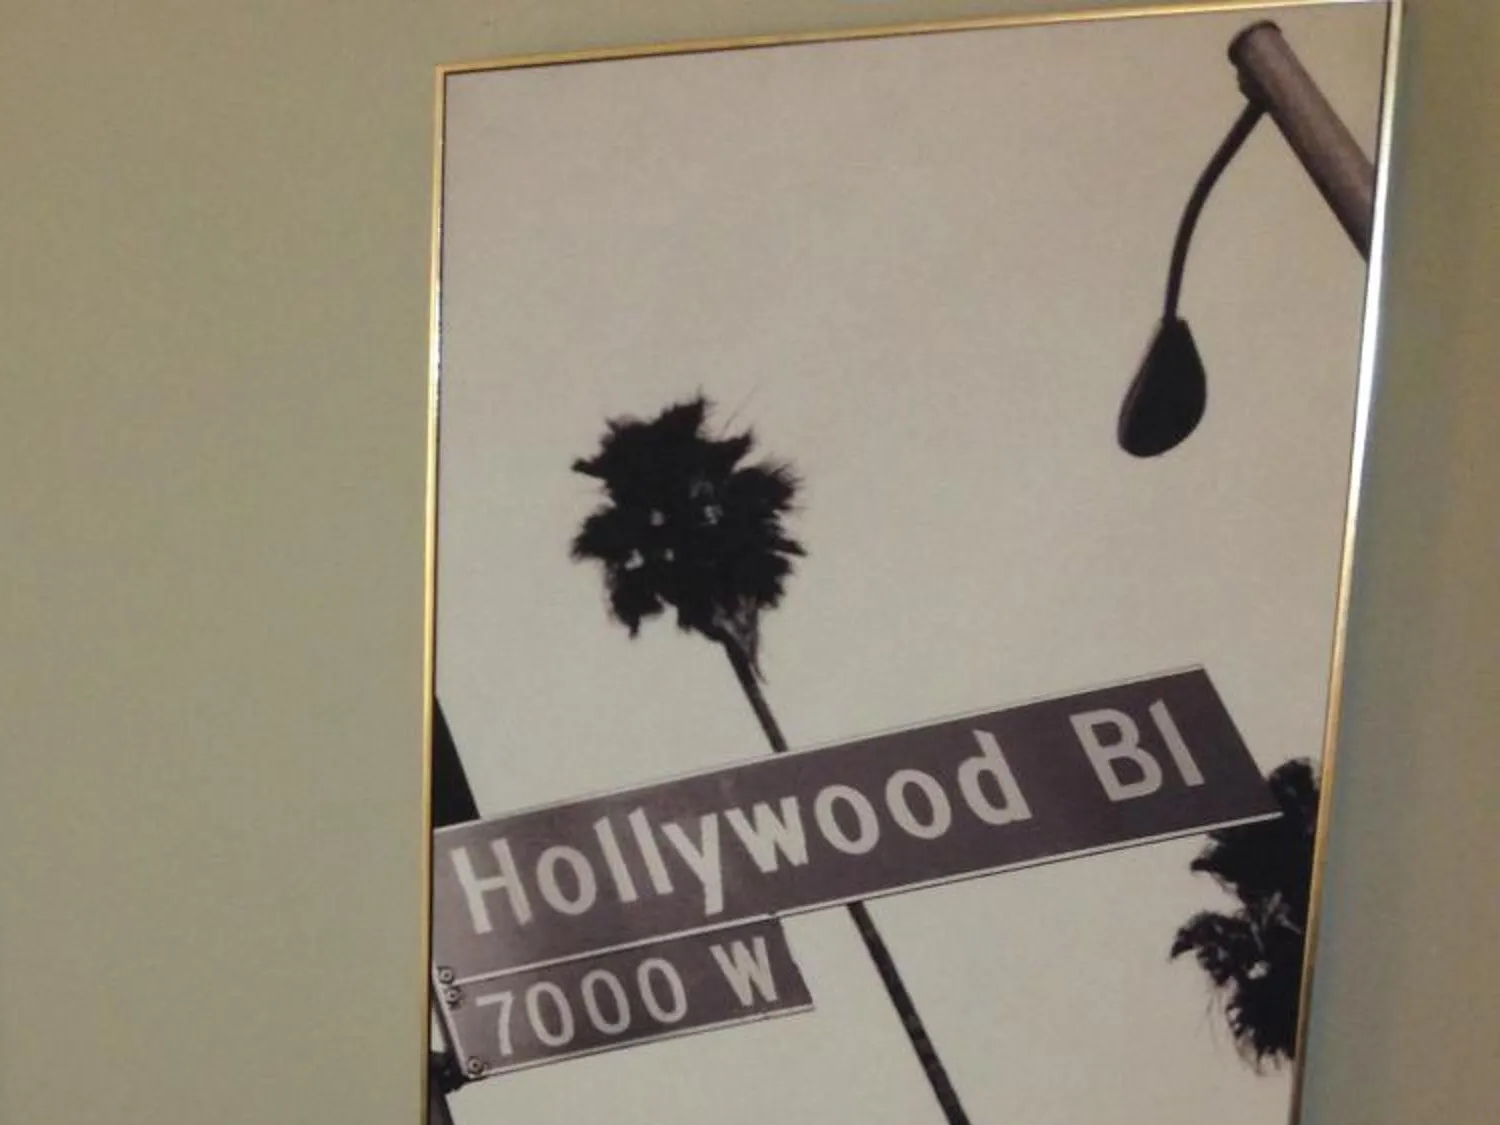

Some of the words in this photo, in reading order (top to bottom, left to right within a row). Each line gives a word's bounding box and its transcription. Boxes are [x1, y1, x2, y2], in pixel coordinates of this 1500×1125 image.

[447, 728, 1032, 936] Hollywood
[1069, 698, 1206, 803] Bl
[475, 956, 689, 1058] 7000
[711, 934, 780, 1010] W
